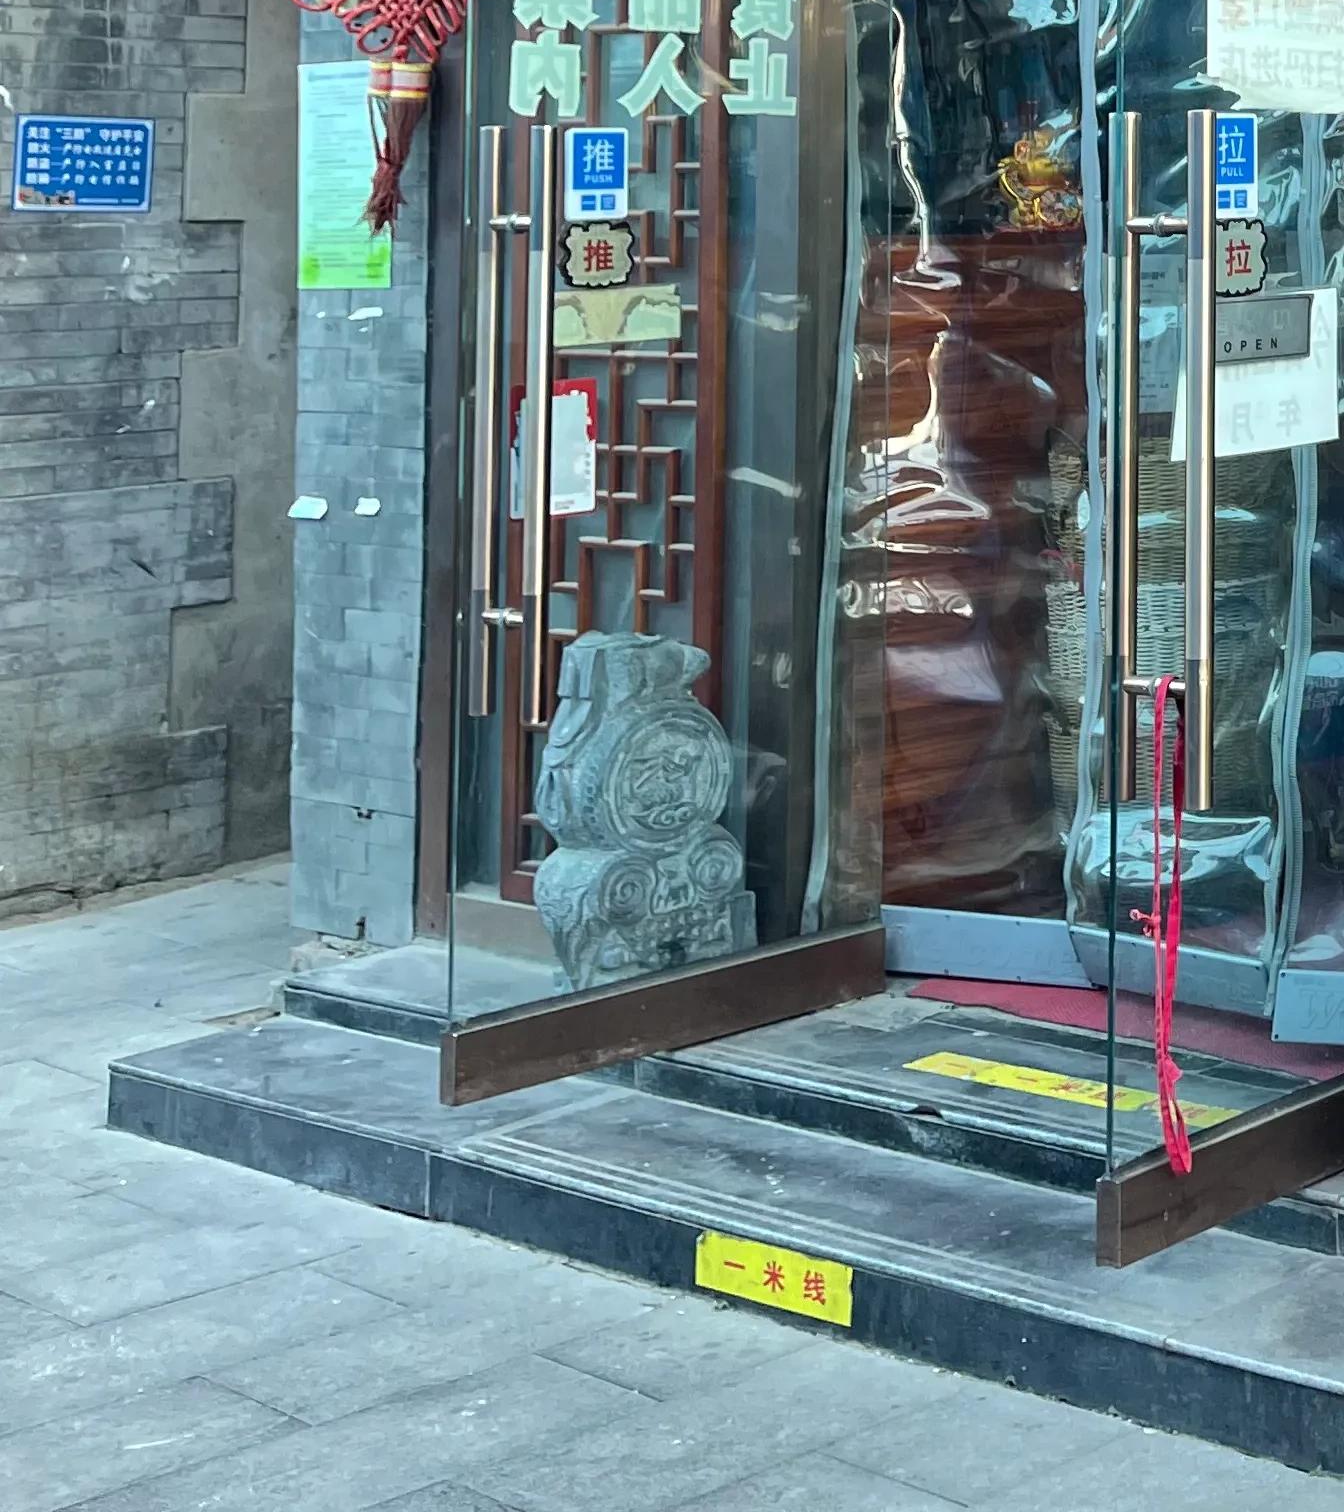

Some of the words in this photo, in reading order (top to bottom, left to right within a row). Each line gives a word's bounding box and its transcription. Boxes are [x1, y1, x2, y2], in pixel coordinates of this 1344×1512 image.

[582, 138, 616, 174] 推
[1218, 125, 1247, 165] 拉
[584, 174, 613, 184] PUSH
[1221, 167, 1244, 178] PULL
[583, 239, 615, 272] 推
[1225, 239, 1252, 277] 拉
[1223, 337, 1279, 354] OPEN
[723, 1260, 827, 1306] 一米线
